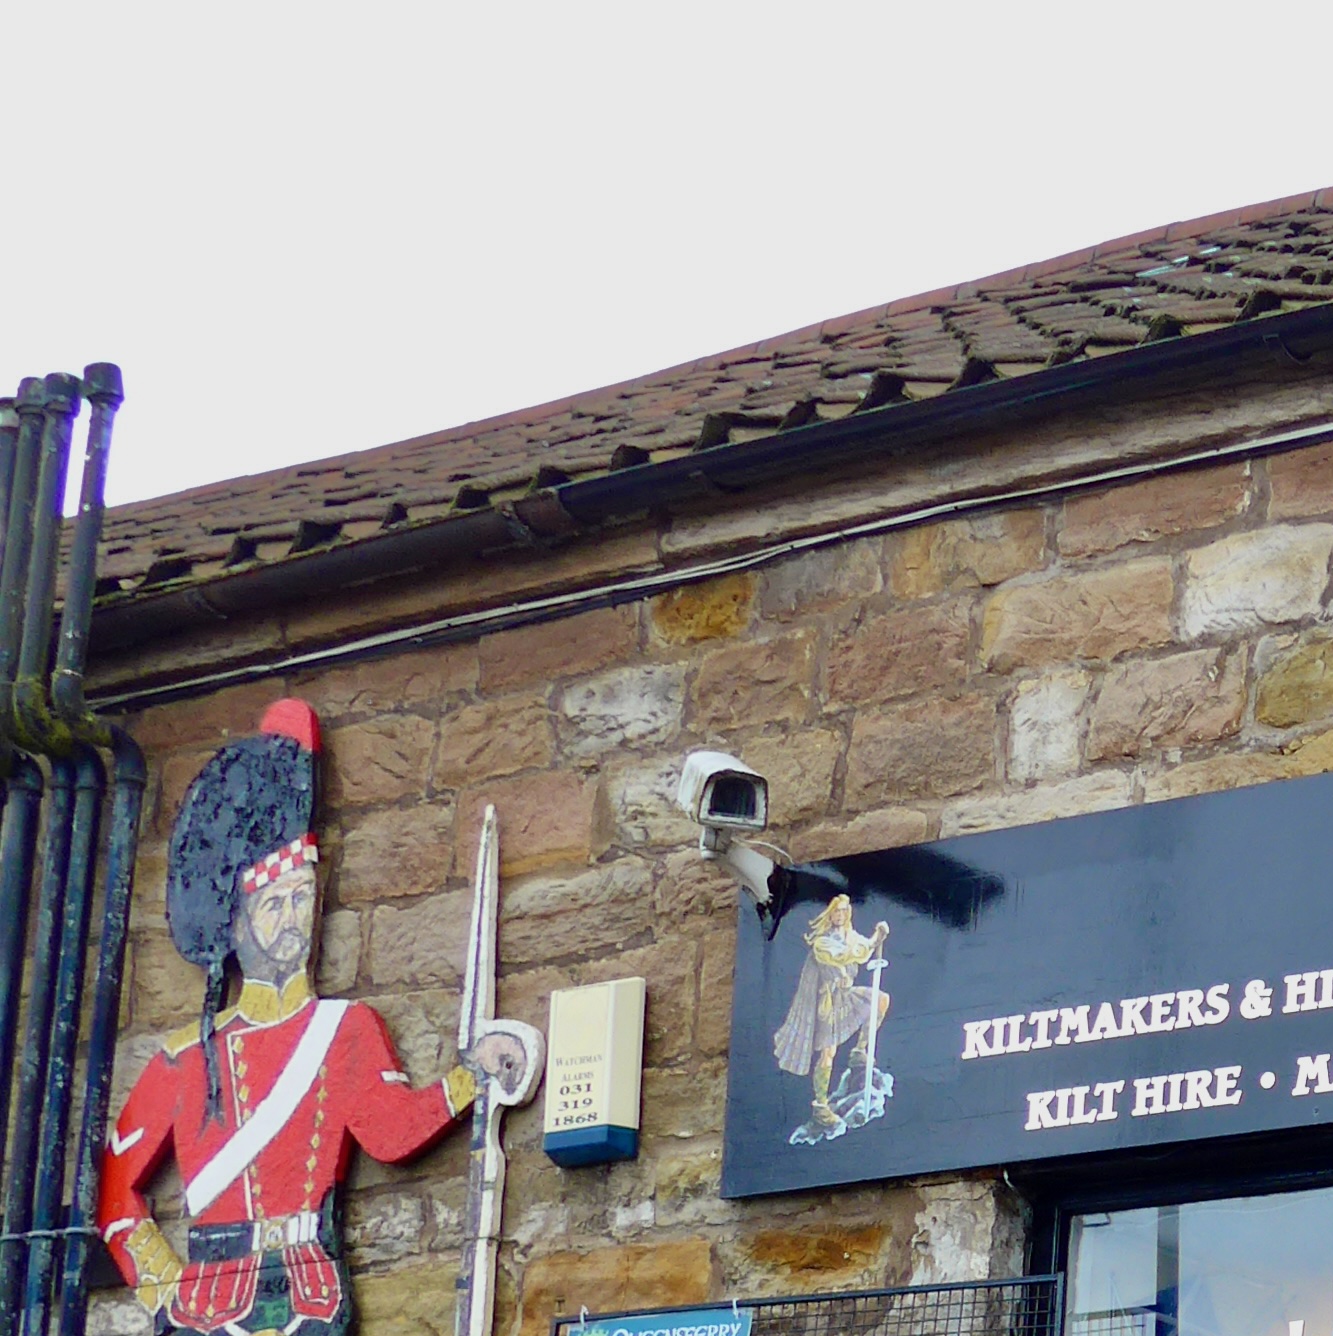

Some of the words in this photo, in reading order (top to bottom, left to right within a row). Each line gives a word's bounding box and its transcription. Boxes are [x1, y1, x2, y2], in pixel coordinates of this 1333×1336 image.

[961, 983, 1229, 1060] KILTMAKERS
[1239, 979, 1274, 1019] &
[559, 1083, 593, 1096] 031
[558, 1098, 593, 1112] 319
[1024, 1080, 1126, 1131] KILT
[1132, 1066, 1243, 1117] HIRE
[553, 1112, 598, 1127] 1868
